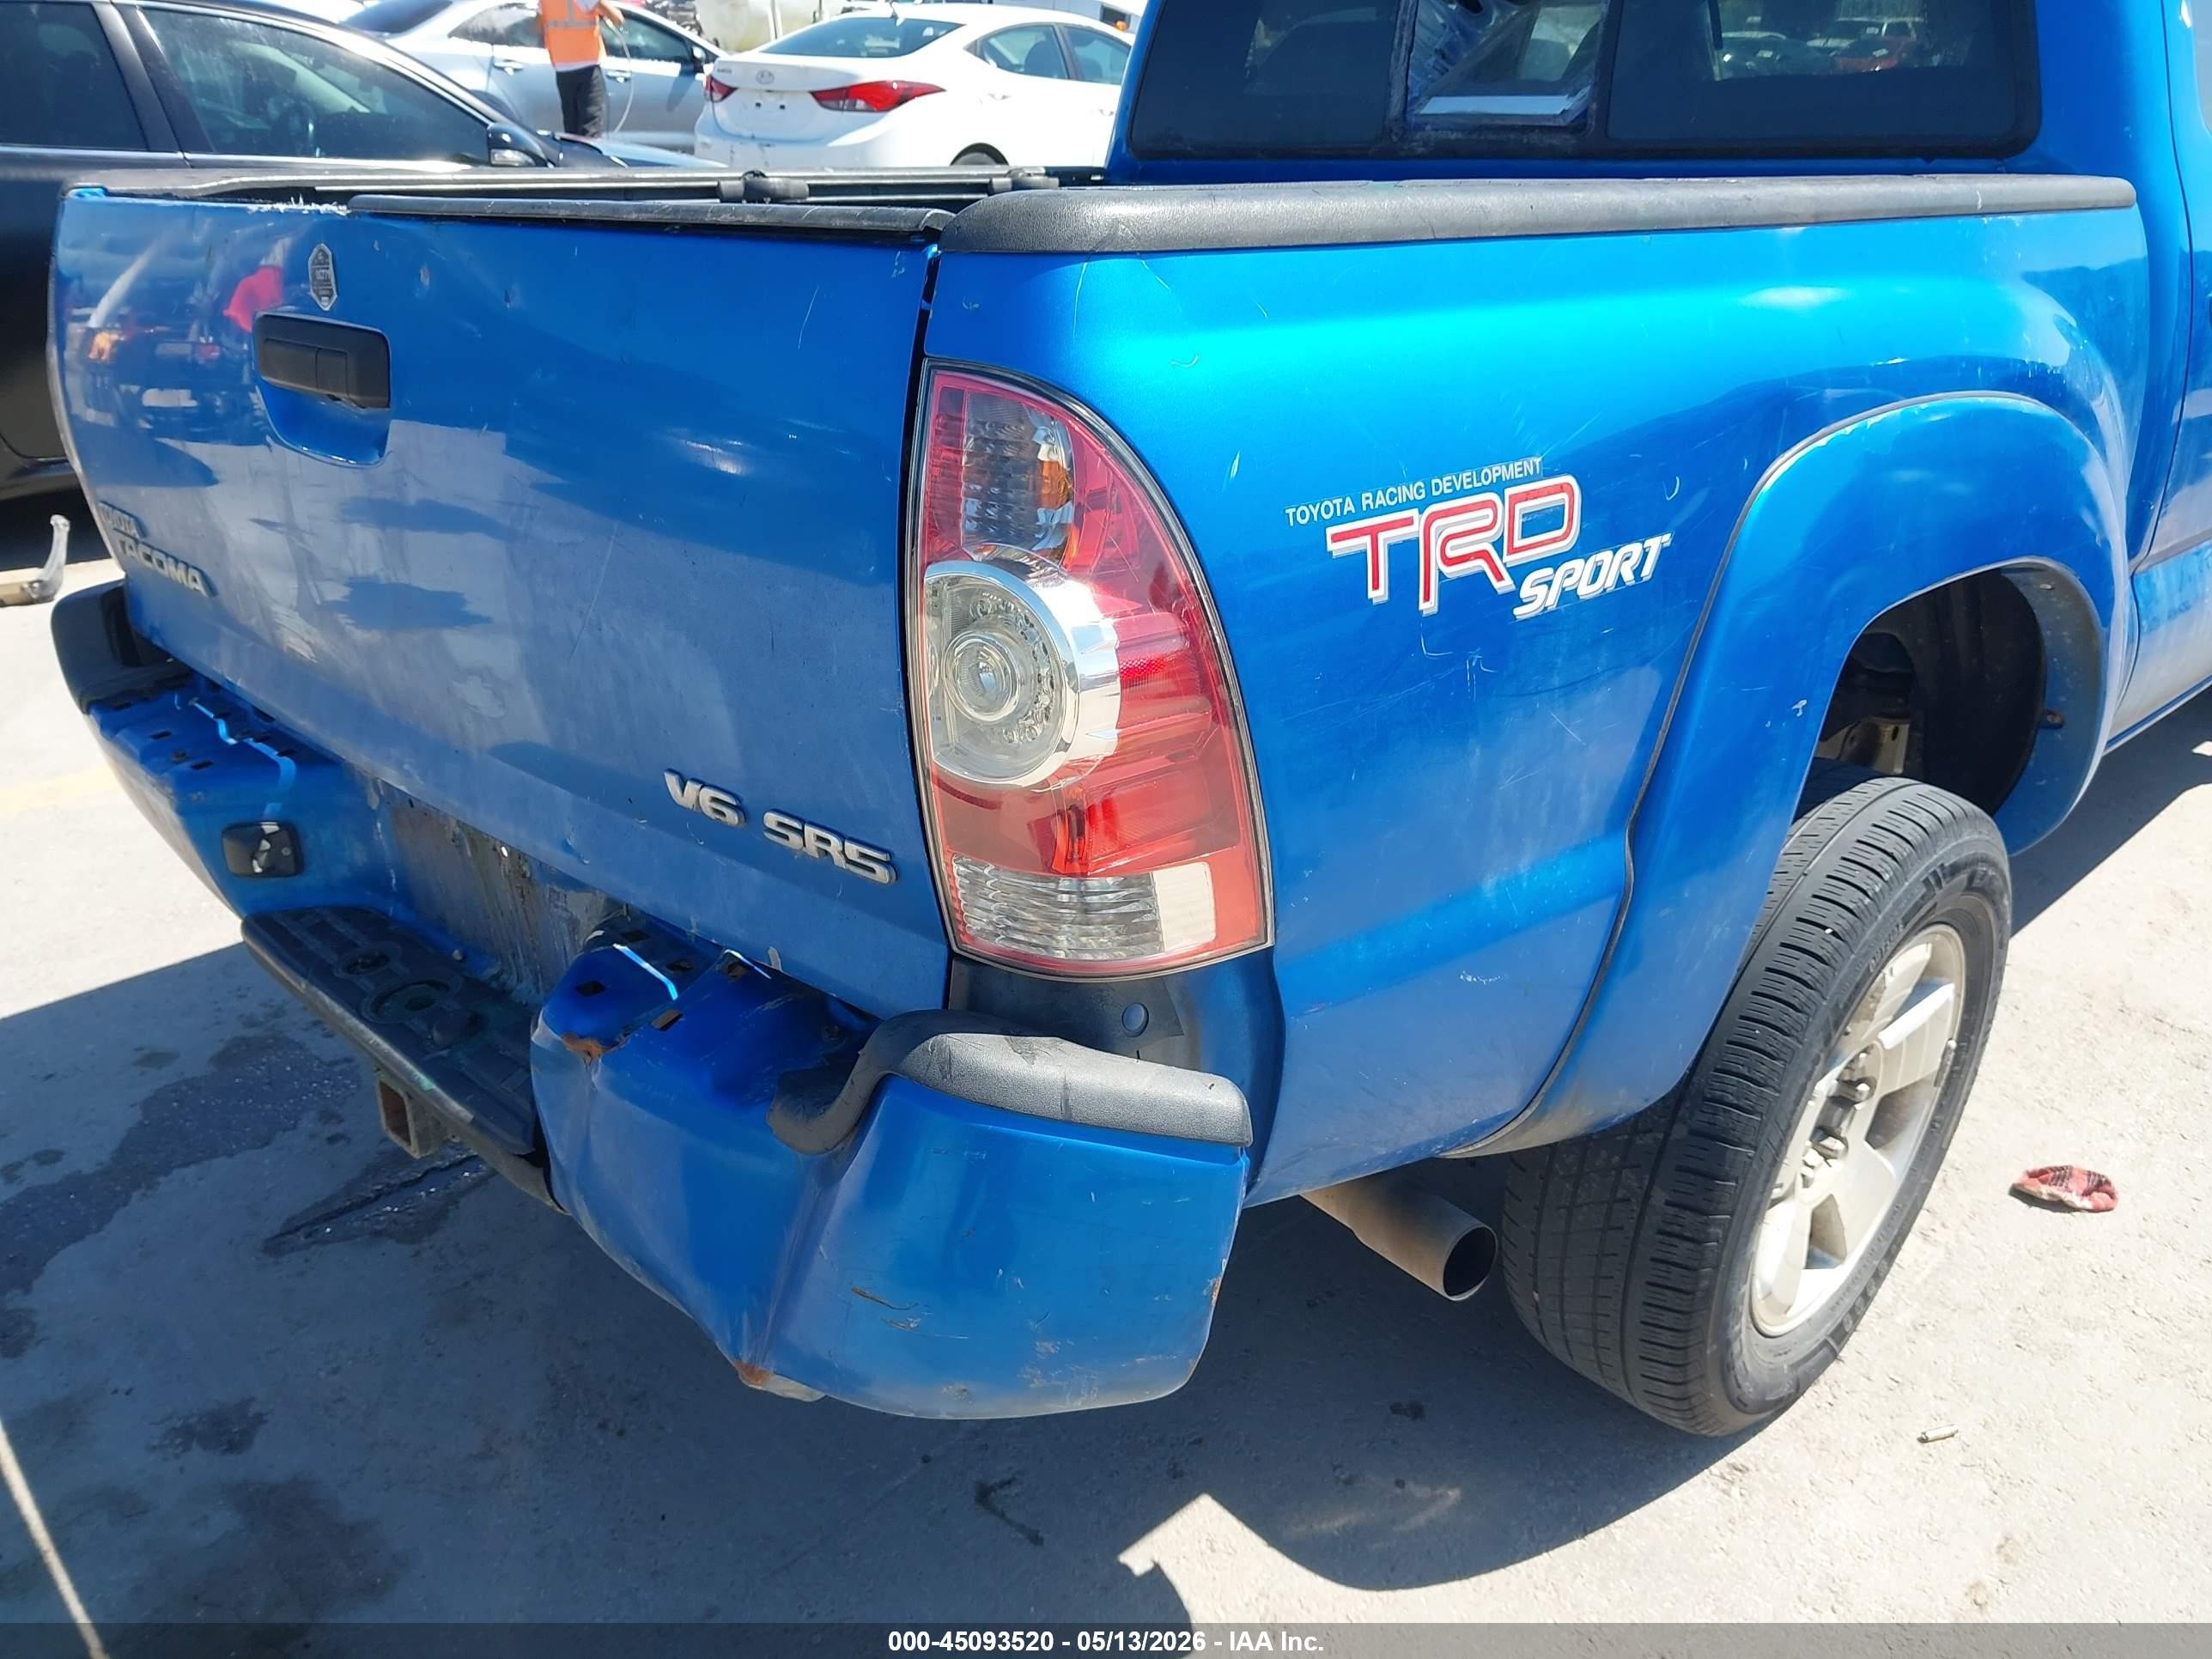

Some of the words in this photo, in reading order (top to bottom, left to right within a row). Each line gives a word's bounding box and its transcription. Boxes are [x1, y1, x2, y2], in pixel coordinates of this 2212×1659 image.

[1285, 495, 1355, 527] TOYOTA
[1361, 482, 1425, 512] RACING
[1431, 458, 1542, 495] DEVELOPMENT
[1326, 474, 1582, 617] TRD
[1512, 532, 1672, 620] SPORT
[664, 769, 746, 827] V6
[763, 810, 897, 884] SR5
